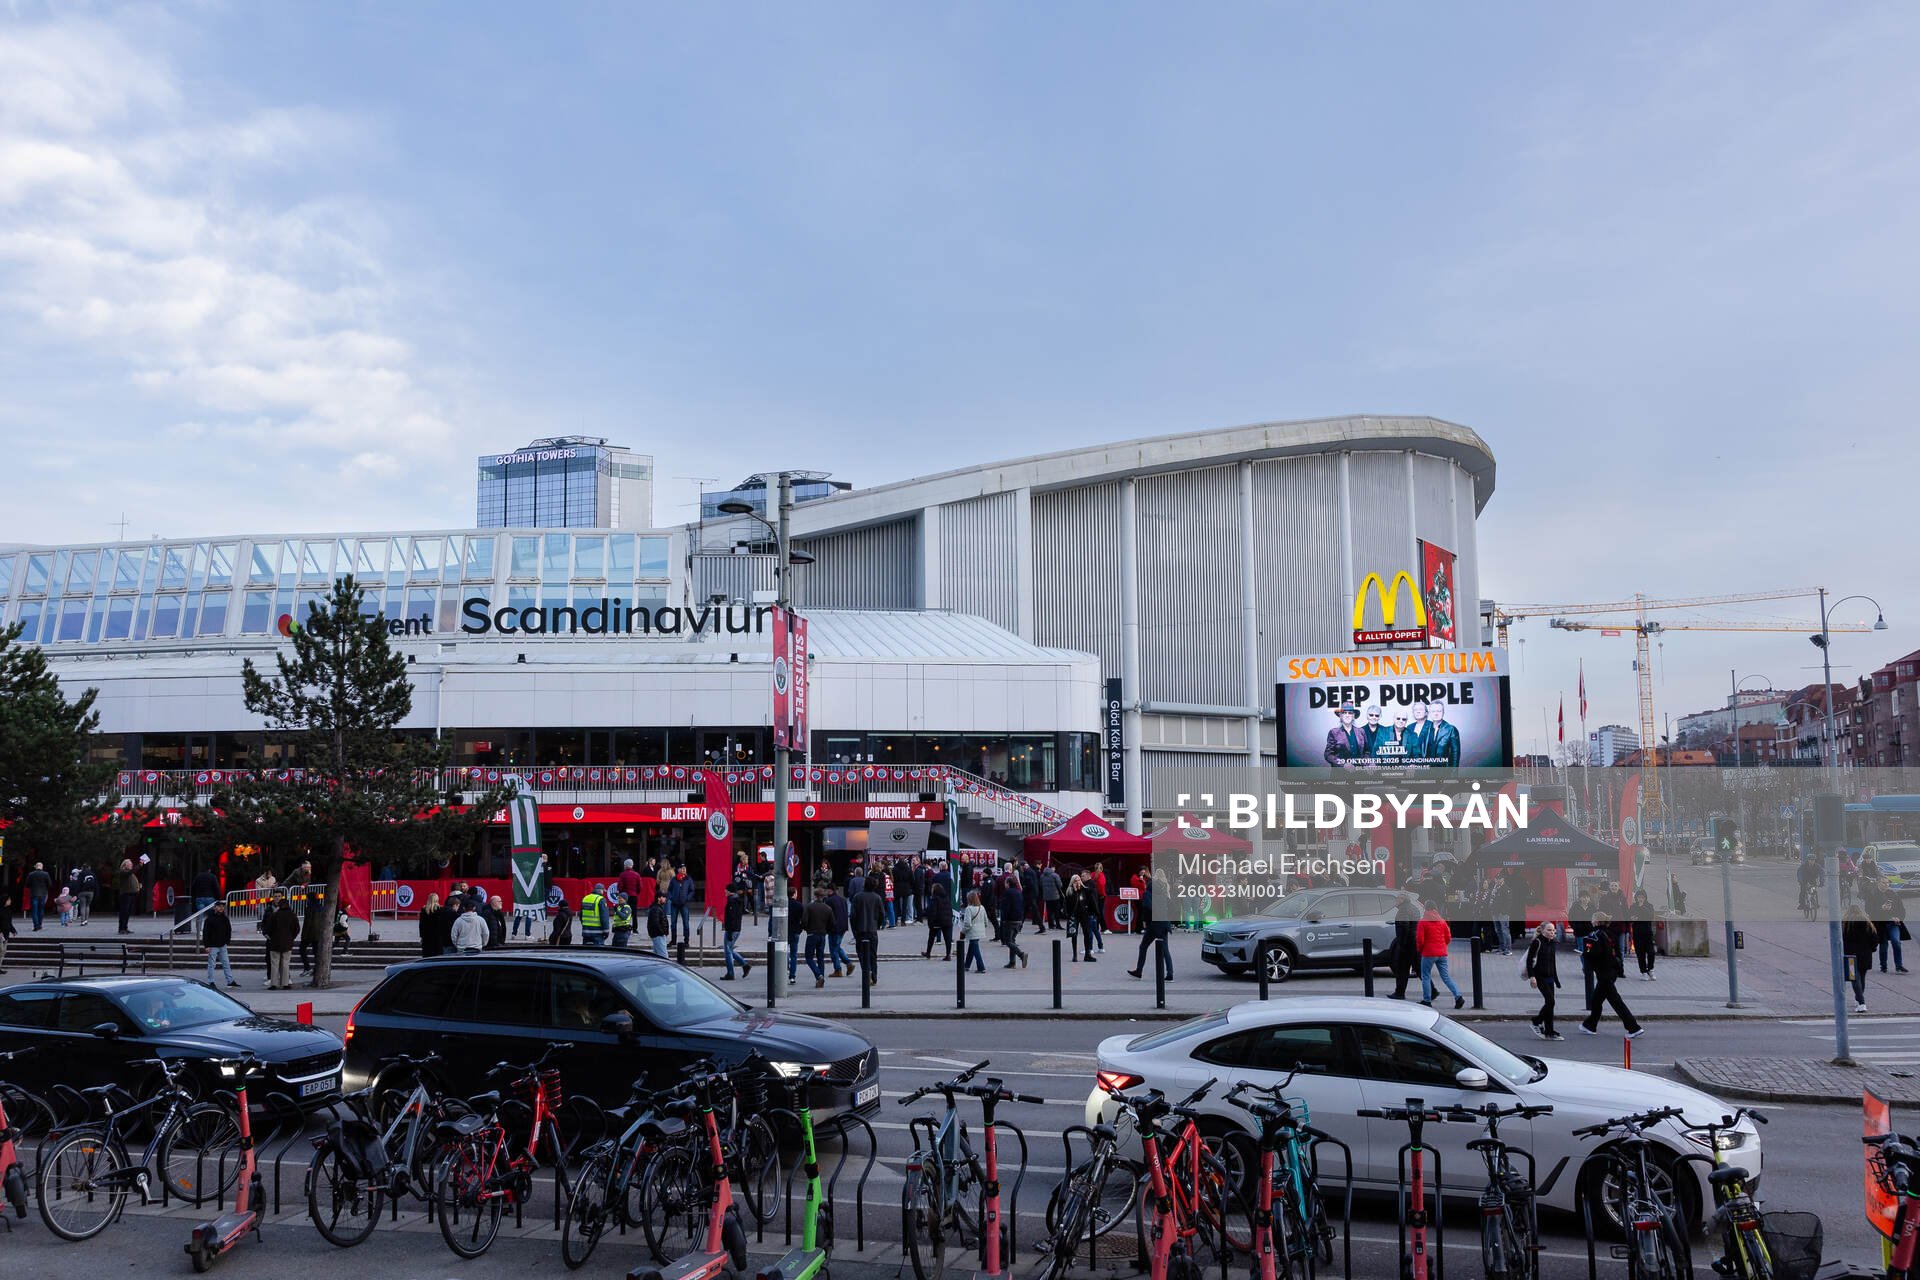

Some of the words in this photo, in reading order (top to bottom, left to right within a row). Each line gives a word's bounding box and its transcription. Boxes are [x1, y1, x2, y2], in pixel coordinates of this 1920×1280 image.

[496, 452, 535, 465] GOTHIA
[537, 449, 576, 461] TOWERS
[1365, 633, 1393, 641] ALLTID
[1394, 630, 1422, 639] ÖPPET
[795, 634, 804, 716] SLUTSPEL
[1288, 652, 1497, 679] SCANDINAVIUM
[1309, 684, 1370, 709] DEEP
[1380, 682, 1474, 707] PURPLE
[1110, 700, 1120, 726] Glöd
[1111, 729, 1120, 749] Kök
[1111, 763, 1121, 782] Bar
[865, 804, 910, 818] BORTAENTRÉ
[305, 1083, 318, 1094] EAP
